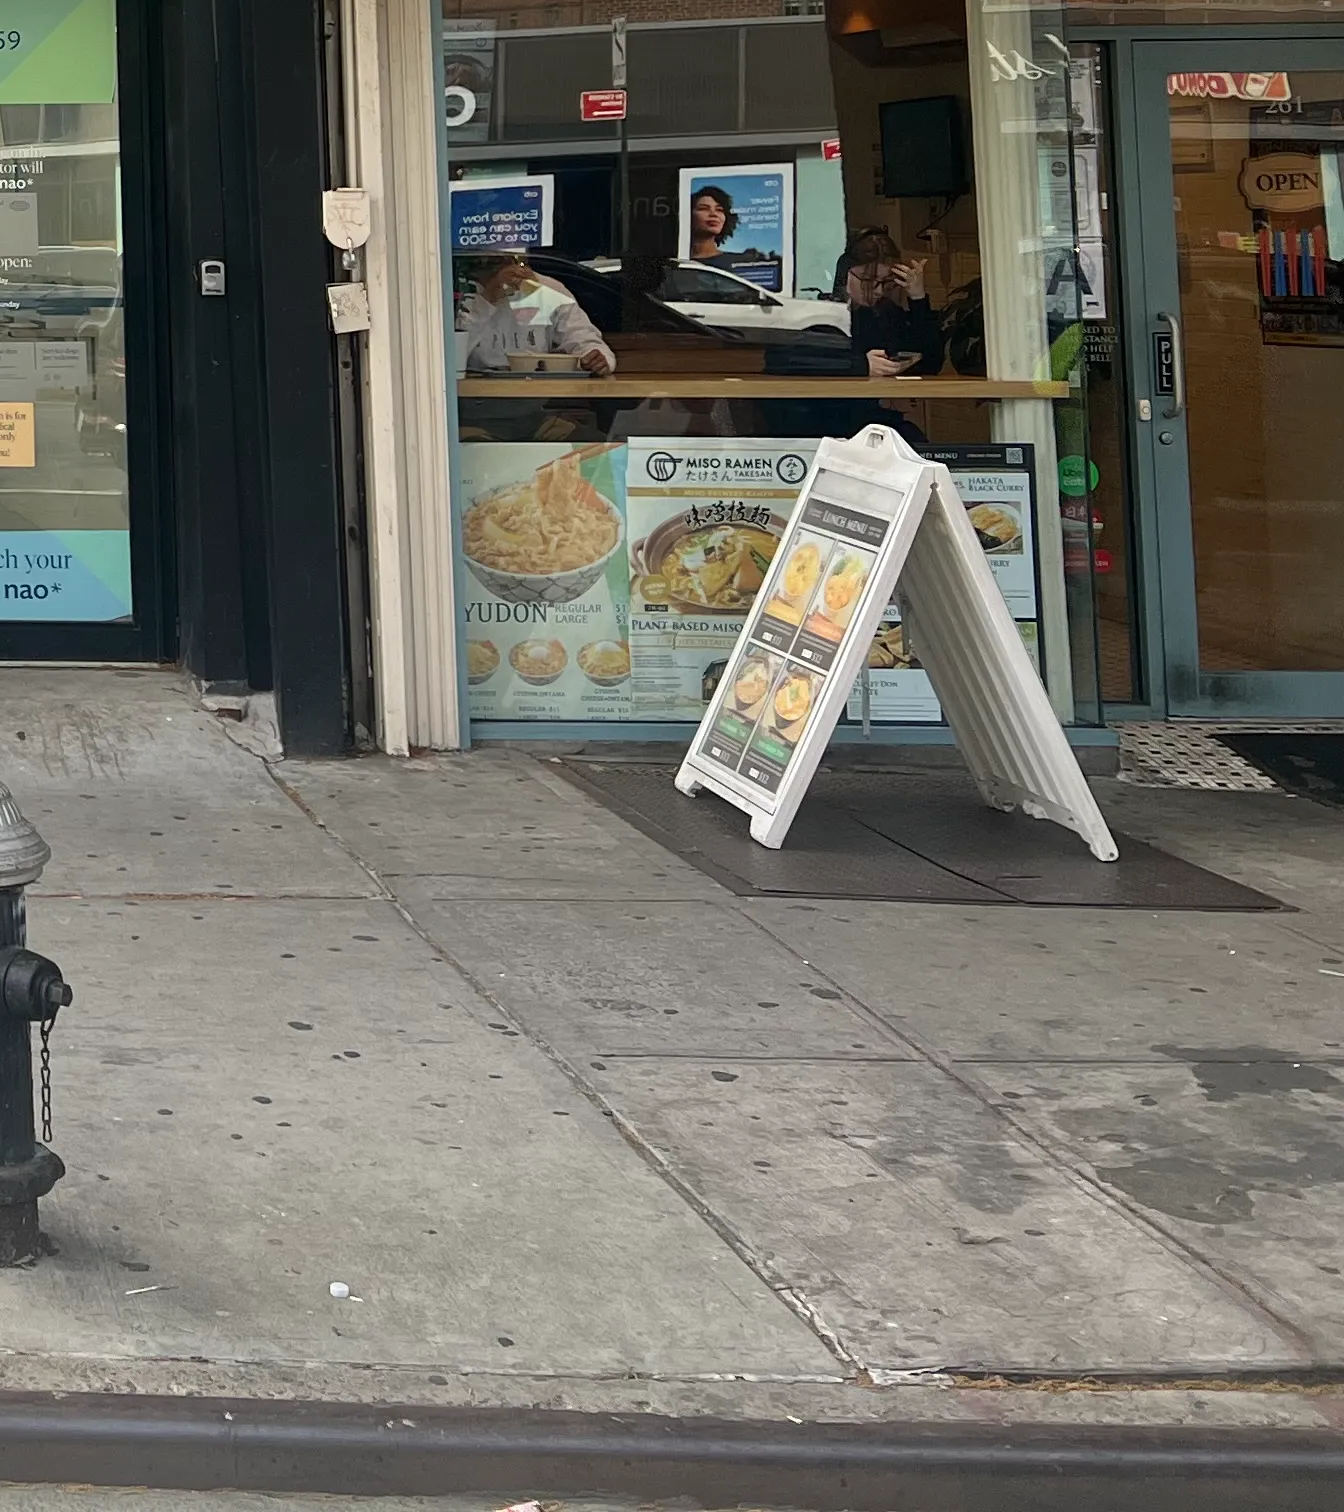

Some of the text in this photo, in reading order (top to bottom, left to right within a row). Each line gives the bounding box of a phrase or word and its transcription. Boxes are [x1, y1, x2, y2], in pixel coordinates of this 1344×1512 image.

[20, 161, 43, 174] will
[1256, 173, 1320, 191] OPEN
[1045, 250, 1094, 295] A
[1161, 341, 1172, 388] PULL
[6, 411, 13, 420] is
[15, 411, 26, 420] for
[686, 458, 772, 470] MISO RAMEN
[685, 470, 733, 482] たけさん
[997, 484, 1024, 492] CURRY
[822, 509, 846, 528] LUNCH
[845, 519, 869, 535] MENU
[555, 603, 602, 613] REGULAR
[555, 614, 588, 624] LARGE
[632, 619, 744, 633] PLANT BASED MISO
